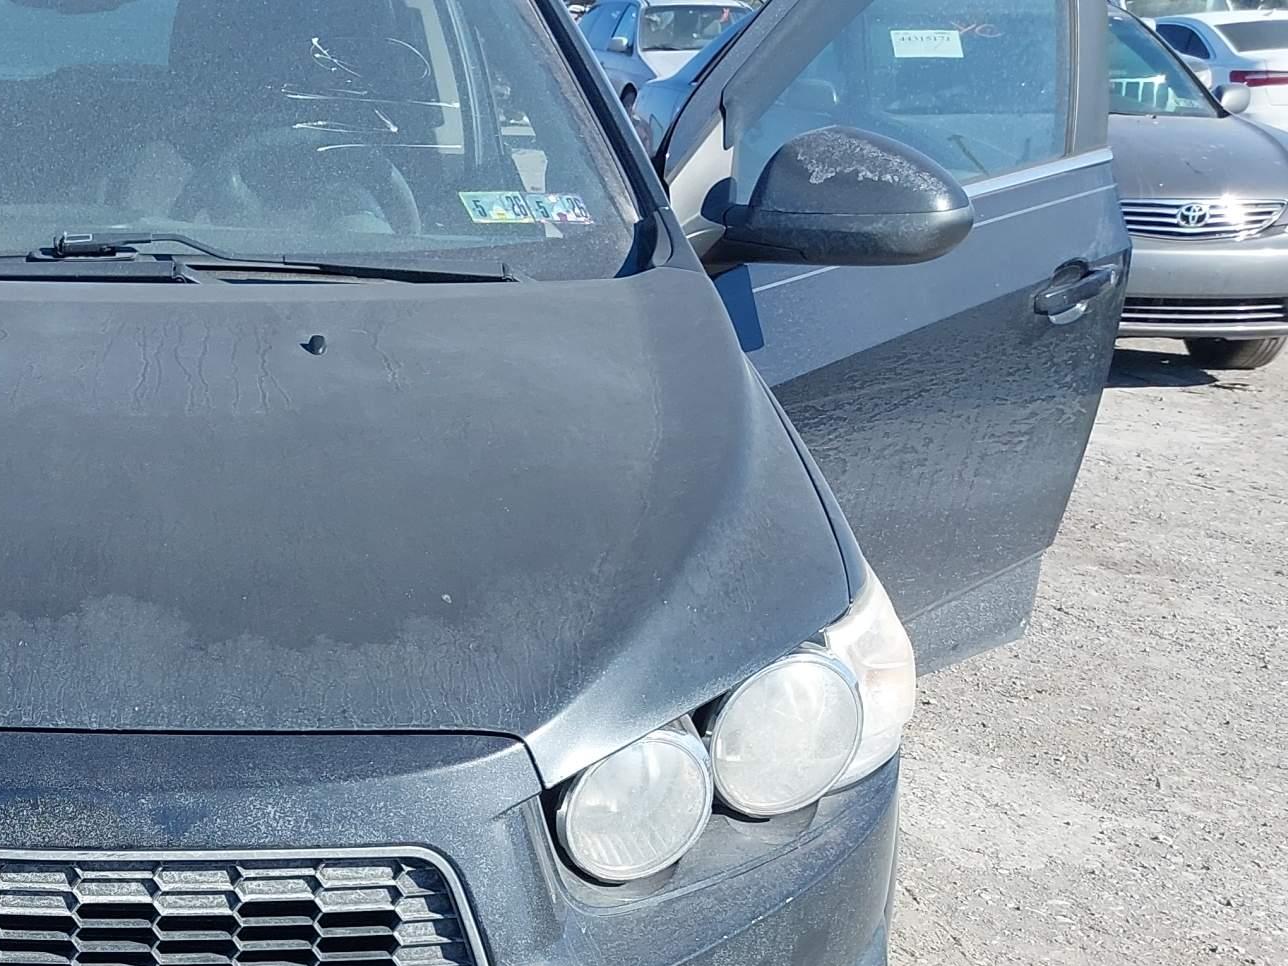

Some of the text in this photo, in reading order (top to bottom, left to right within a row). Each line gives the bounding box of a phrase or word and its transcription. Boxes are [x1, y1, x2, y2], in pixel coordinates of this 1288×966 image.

[472, 195, 529, 218] 5 26
[535, 200, 550, 219] 5
